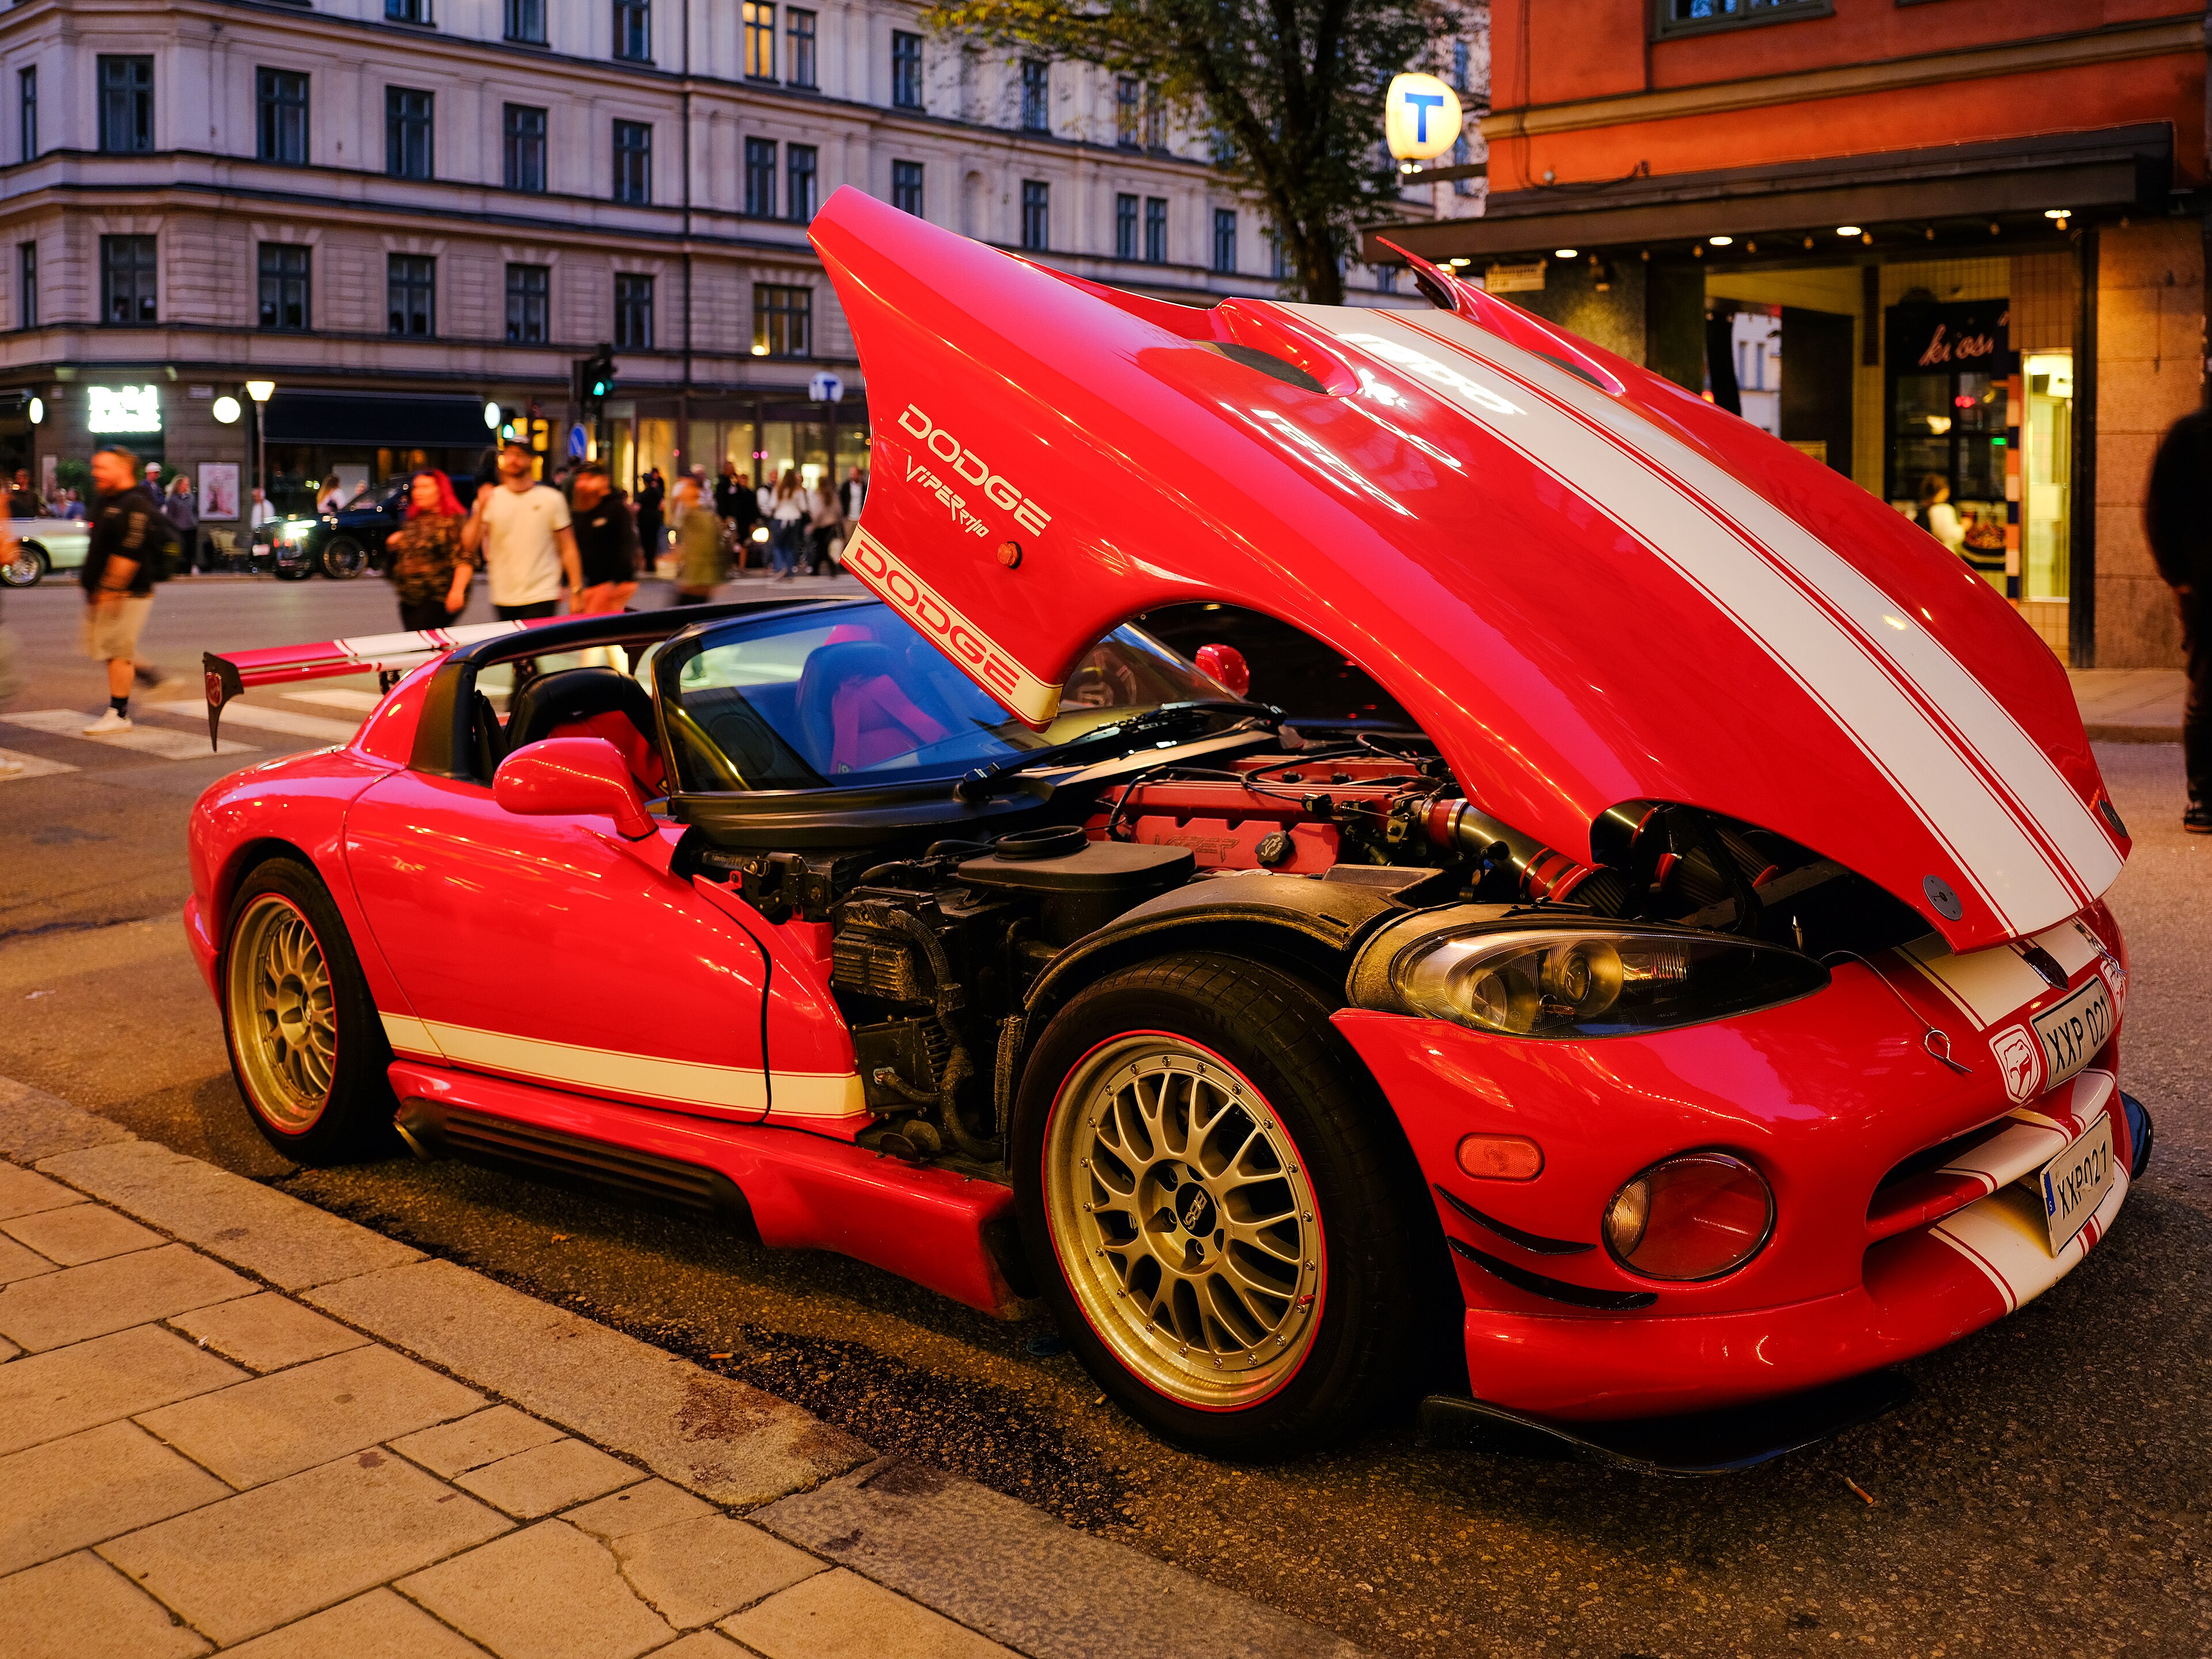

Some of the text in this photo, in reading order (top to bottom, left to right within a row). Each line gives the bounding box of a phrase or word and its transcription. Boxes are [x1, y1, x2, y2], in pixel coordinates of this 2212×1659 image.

[1405, 92, 1443, 143] T
[823, 380, 836, 400] T
[897, 403, 1052, 537] DODGE
[854, 539, 1020, 696] DODGE
[2046, 995, 2109, 1074] XXP 021
[1183, 1190, 1207, 1230] BBS
[2048, 1200, 2052, 1211] S
